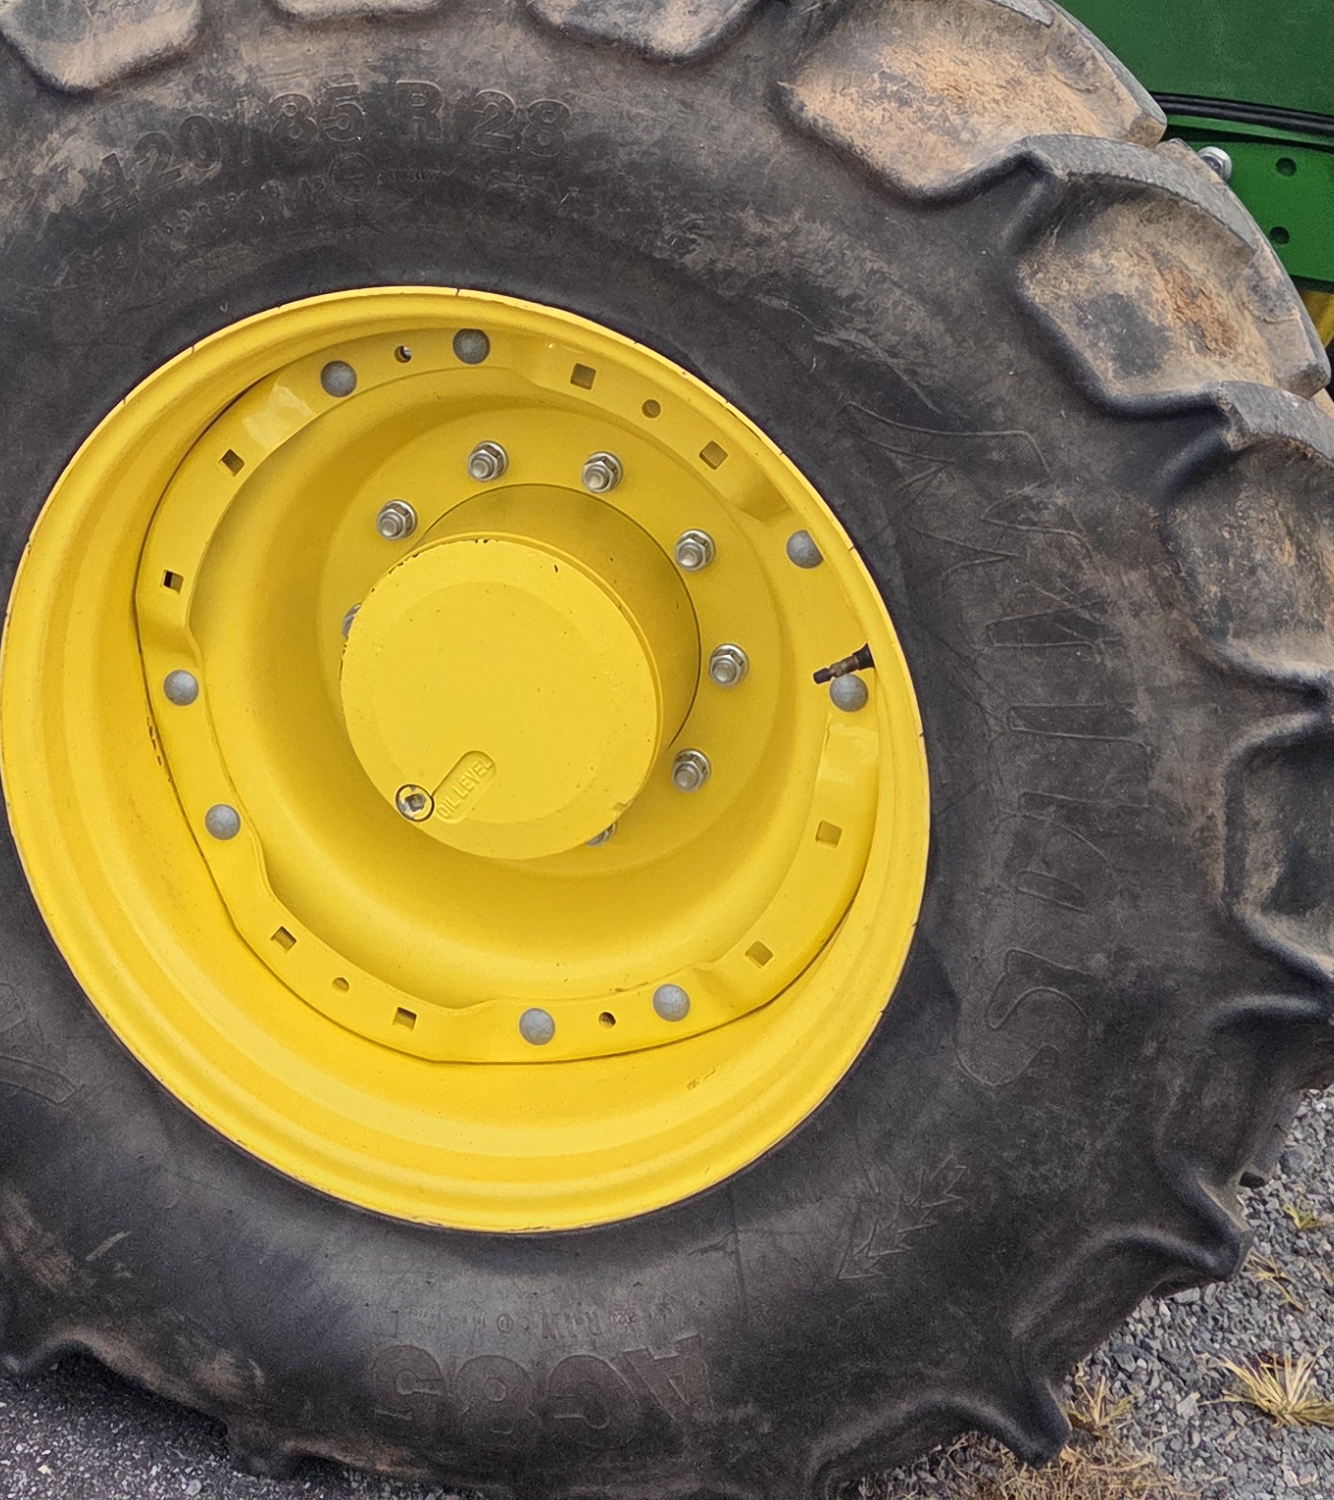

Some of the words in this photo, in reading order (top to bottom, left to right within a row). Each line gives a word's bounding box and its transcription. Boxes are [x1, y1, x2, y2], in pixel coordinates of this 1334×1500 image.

[469, 88, 573, 159] 28
[436, 794, 462, 818] OIL
[451, 760, 495, 800] LEVEL
